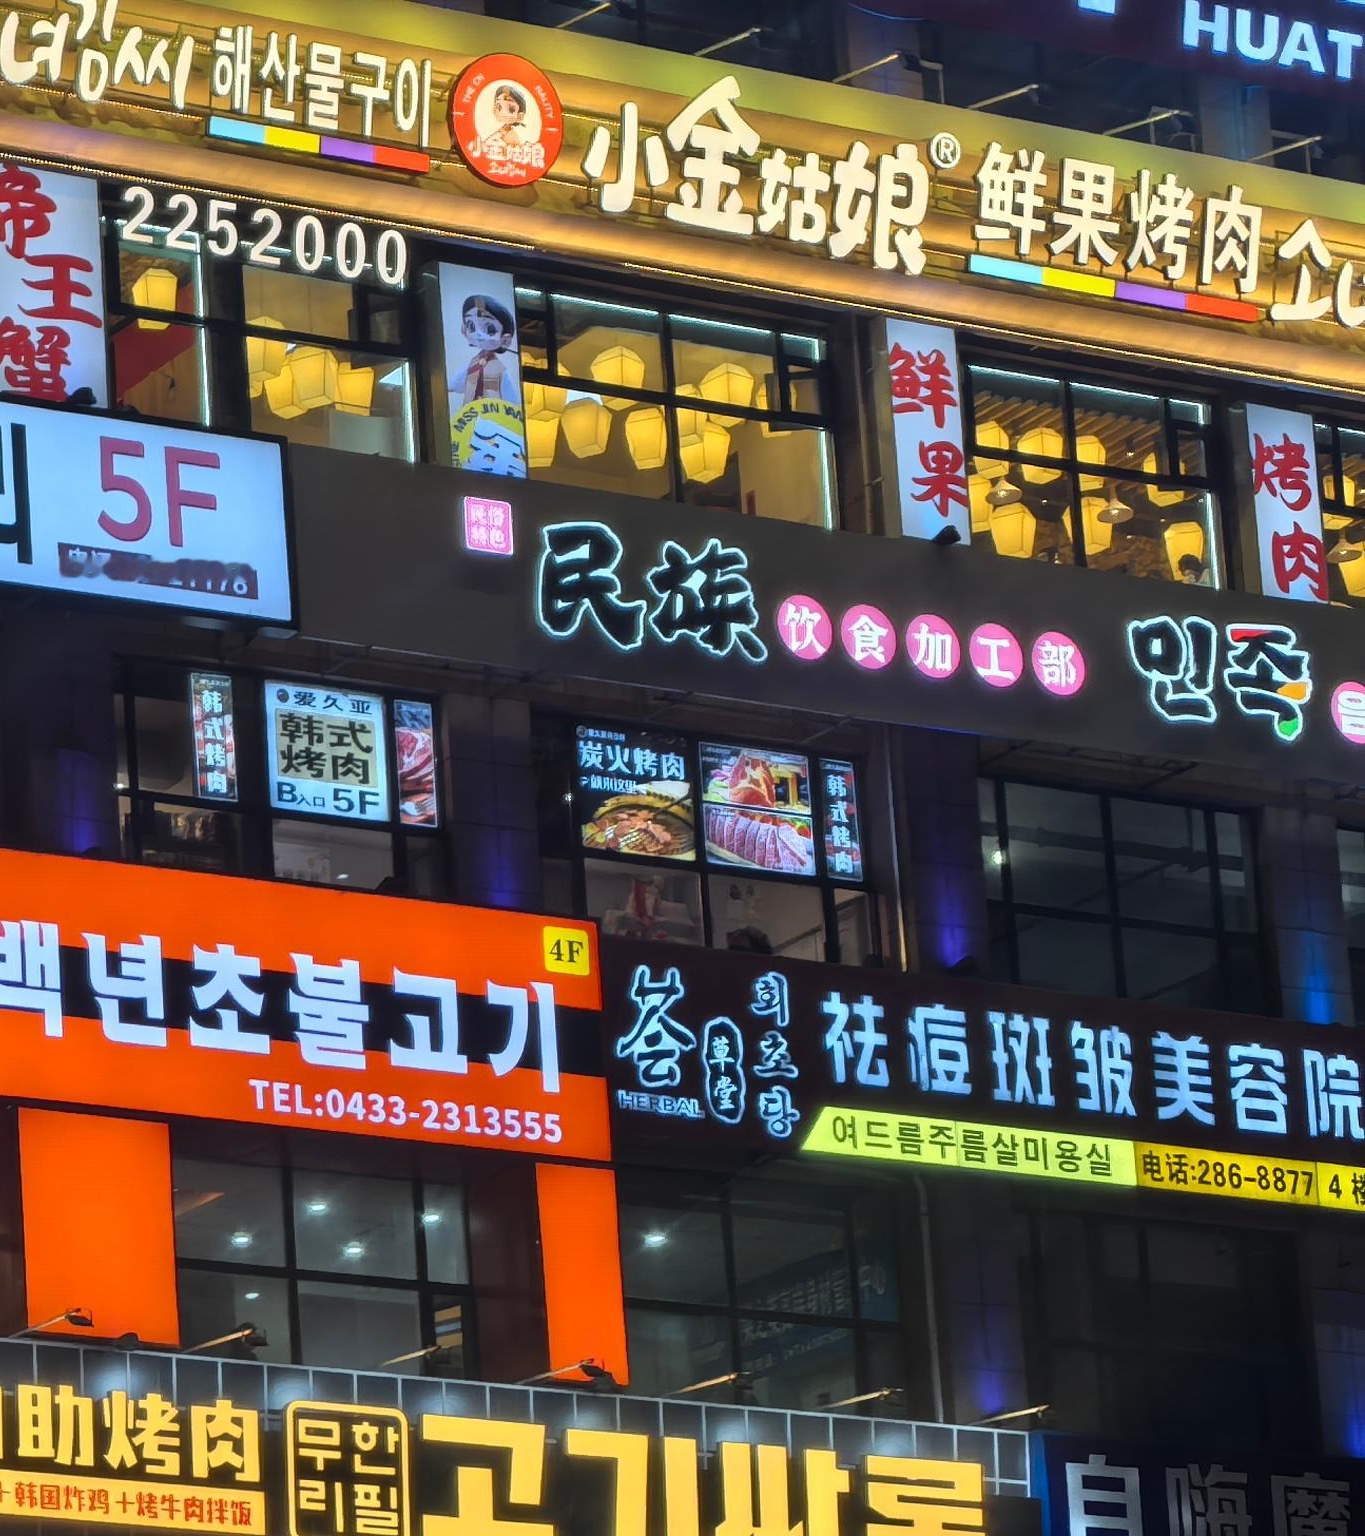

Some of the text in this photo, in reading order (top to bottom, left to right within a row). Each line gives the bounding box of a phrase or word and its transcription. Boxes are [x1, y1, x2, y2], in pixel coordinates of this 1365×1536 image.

[1183, 0, 1364, 80] HUAT
[212, 24, 432, 155] 해산물구이
[582, 75, 1263, 295] 小金姑娘 鲜果烤肉
[122, 186, 409, 286] 2252000
[887, 343, 968, 520] 鲜果
[96, 436, 221, 547] 5F
[1251, 432, 1330, 603] 烤肉
[536, 520, 1081, 690] 民族 饮食加工部
[1127, 615, 1313, 742] 민족
[279, 712, 373, 753] 韩式
[279, 745, 370, 784] 烤肉
[577, 741, 685, 780] 炭火烤肉
[333, 788, 380, 815] 5F
[548, 937, 585, 966] 4F
[708, 1035, 738, 1110] 草堂
[822, 990, 1365, 1142] 祛痘斑皱美容院
[248, 1079, 564, 1146] TEL:0433-2313555
[617, 1089, 706, 1119] HERBAL
[831, 1114, 1113, 1178] 여드름주름살미용실
[1141, 1149, 1315, 1198] 电话:286-8877
[296, 1419, 400, 1475] 무한
[298, 1479, 400, 1536] 리필
